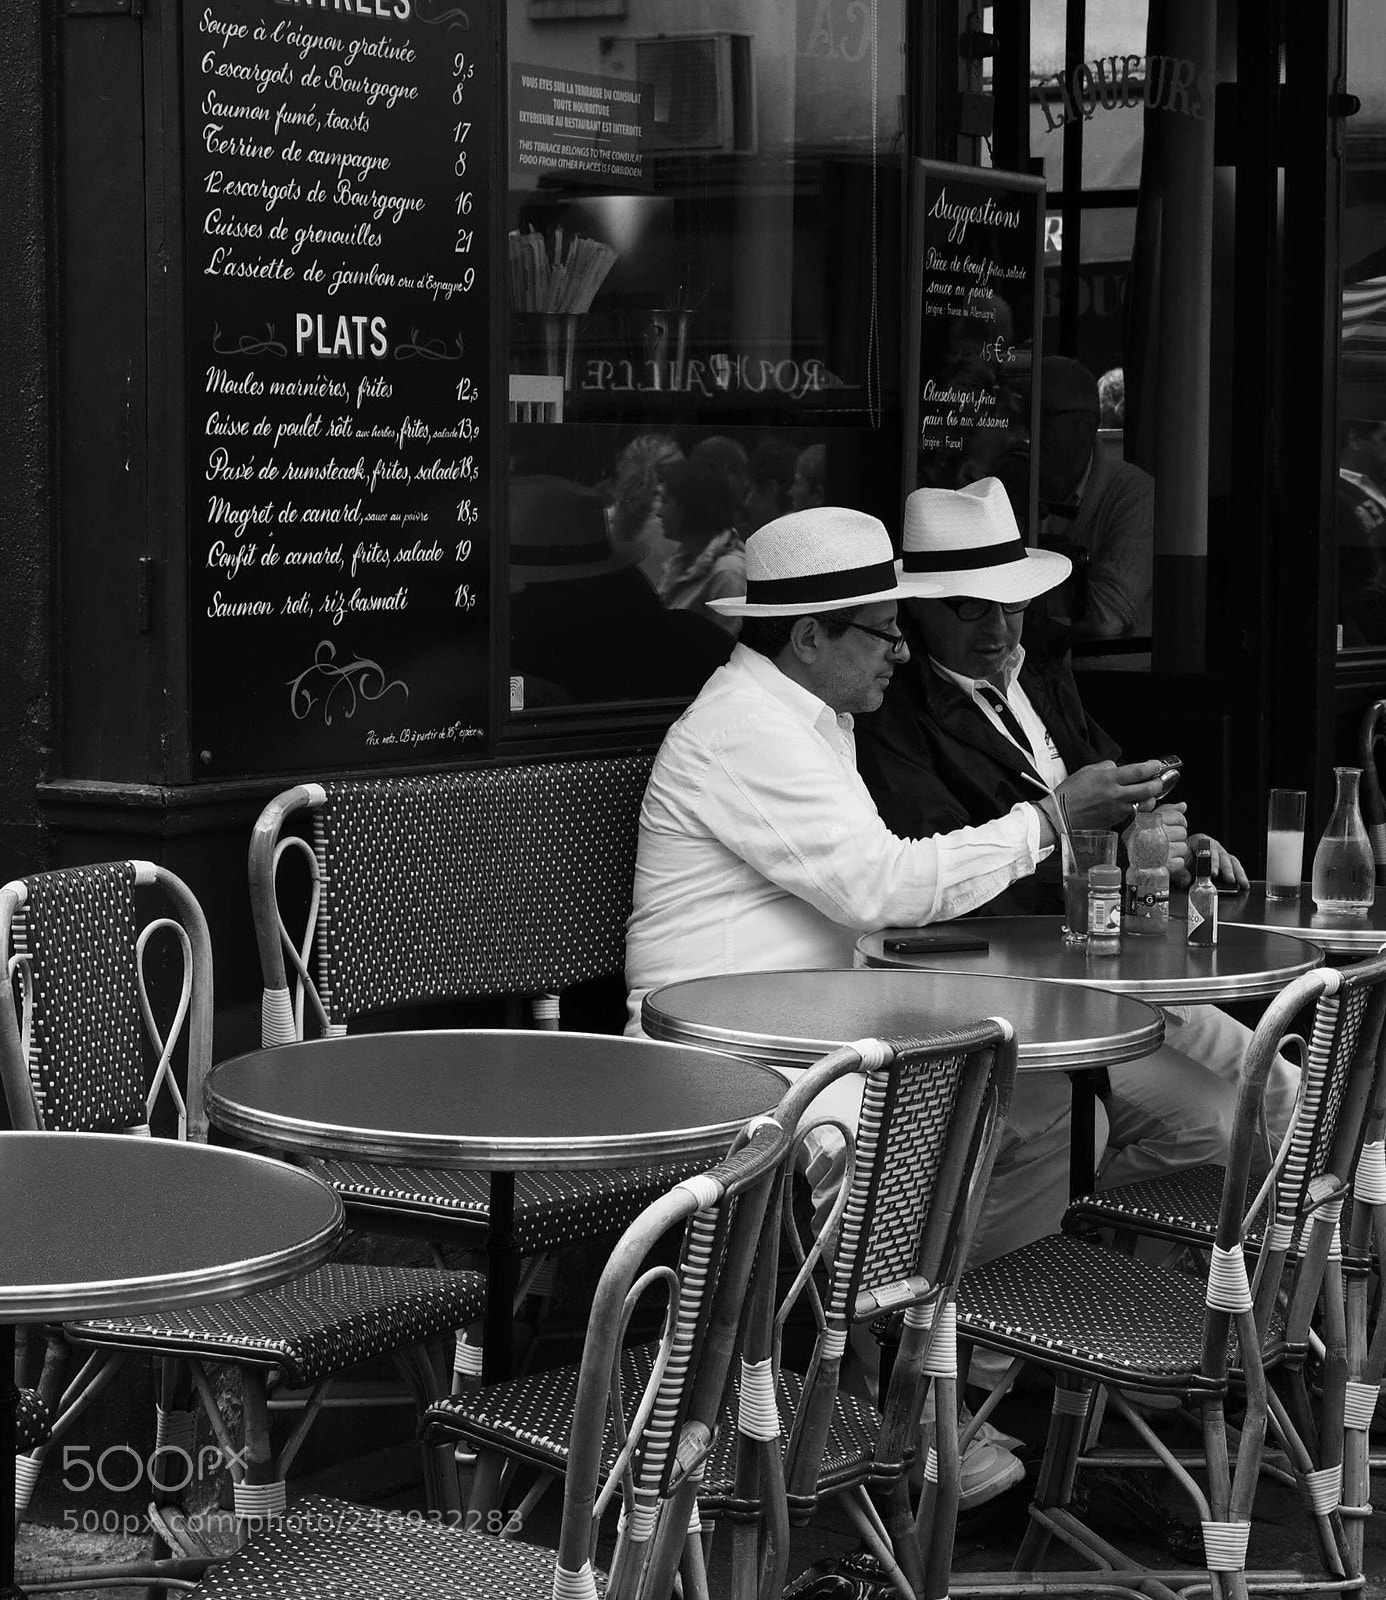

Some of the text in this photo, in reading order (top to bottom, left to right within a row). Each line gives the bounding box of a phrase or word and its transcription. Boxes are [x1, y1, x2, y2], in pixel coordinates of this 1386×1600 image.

[200, 8, 248, 48] Soupe
[254, 19, 266, 40] à
[270, 20, 344, 59] l'oignon
[344, 36, 416, 66] gratinée
[452, 52, 474, 80] 9,5
[202, 50, 464, 108] 6 escargots de Bourgogne 8
[522, 75, 641, 104] VOUS ETES SUR LA TERRASSE DU CONSULAT
[202, 90, 471, 143] Saumon fumé, toasts 17
[519, 111, 641, 137] EXTERIEURE AU RESTAURANT EST INTERDITE
[553, 99, 609, 116] TOUTE NOURRITURE
[202, 123, 466, 182] Terrine de campagne 8
[519, 140, 642, 163] THIS TERRACE BELONGS TO THE CONSULAT
[519, 154, 642, 177] FOOD FROM OTHER PLACES IS FORBIDDEN
[204, 170, 472, 223] 12 escargots de Bourgogne 16
[928, 187, 1020, 244] Suggestions
[203, 208, 473, 255] Cuisses de grenouilles 21
[204, 247, 474, 301] L'assiette de jambon cru d'Espagne 9
[926, 247, 949, 270] Pièce
[950, 255, 961, 272] de
[1005, 265, 1026, 279] salade
[926, 281, 994, 304] sauce au poivre
[947, 303, 962, 316] France
[296, 312, 388, 360] PLATS
[206, 366, 264, 396] Moules
[357, 375, 393, 410] frites
[456, 378, 478, 403] 12,5
[923, 379, 996, 413] Cheeseburger, frites
[205, 411, 250, 437] Cuisse
[252, 416, 272, 437] de
[274, 412, 322, 448] poulet
[329, 416, 352, 438] rôti
[356, 430, 370, 438] aux
[400, 416, 432, 449] frites,
[432, 428, 458, 438] salade
[922, 409, 1009, 434] pain bio aux sésames
[206, 447, 479, 494] Pavé de rumsteack, frites, salade 18,5
[208, 496, 478, 537] Magret de canard, sauce au poivre 18,5
[206, 540, 472, 580] Confit de canard, frites, salade 19
[207, 584, 476, 626] Saumon roti, riz basmati 18,5
